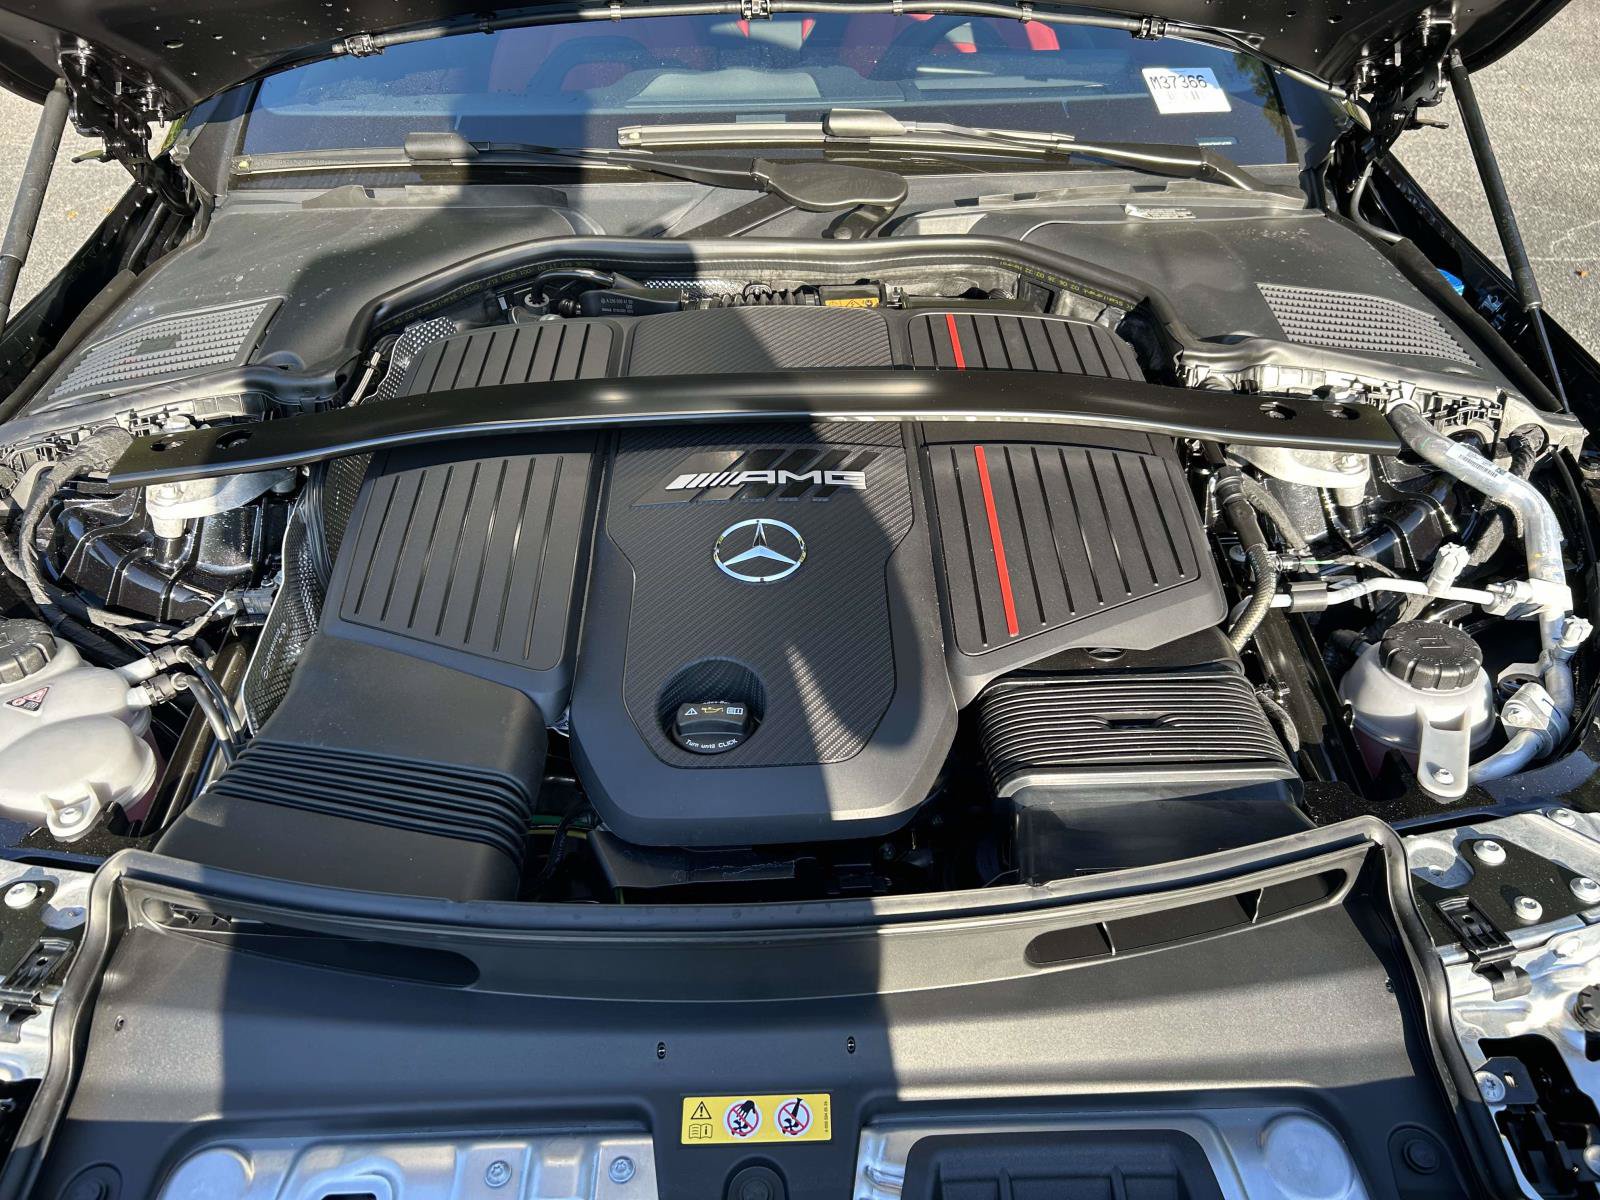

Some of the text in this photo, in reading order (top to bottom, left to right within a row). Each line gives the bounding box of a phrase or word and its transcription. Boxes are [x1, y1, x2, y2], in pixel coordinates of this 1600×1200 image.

[1149, 74, 1208, 90] M37366
[729, 469, 868, 490] AMG
[685, 738, 699, 748] Turn
[718, 738, 738, 748] CLICK
